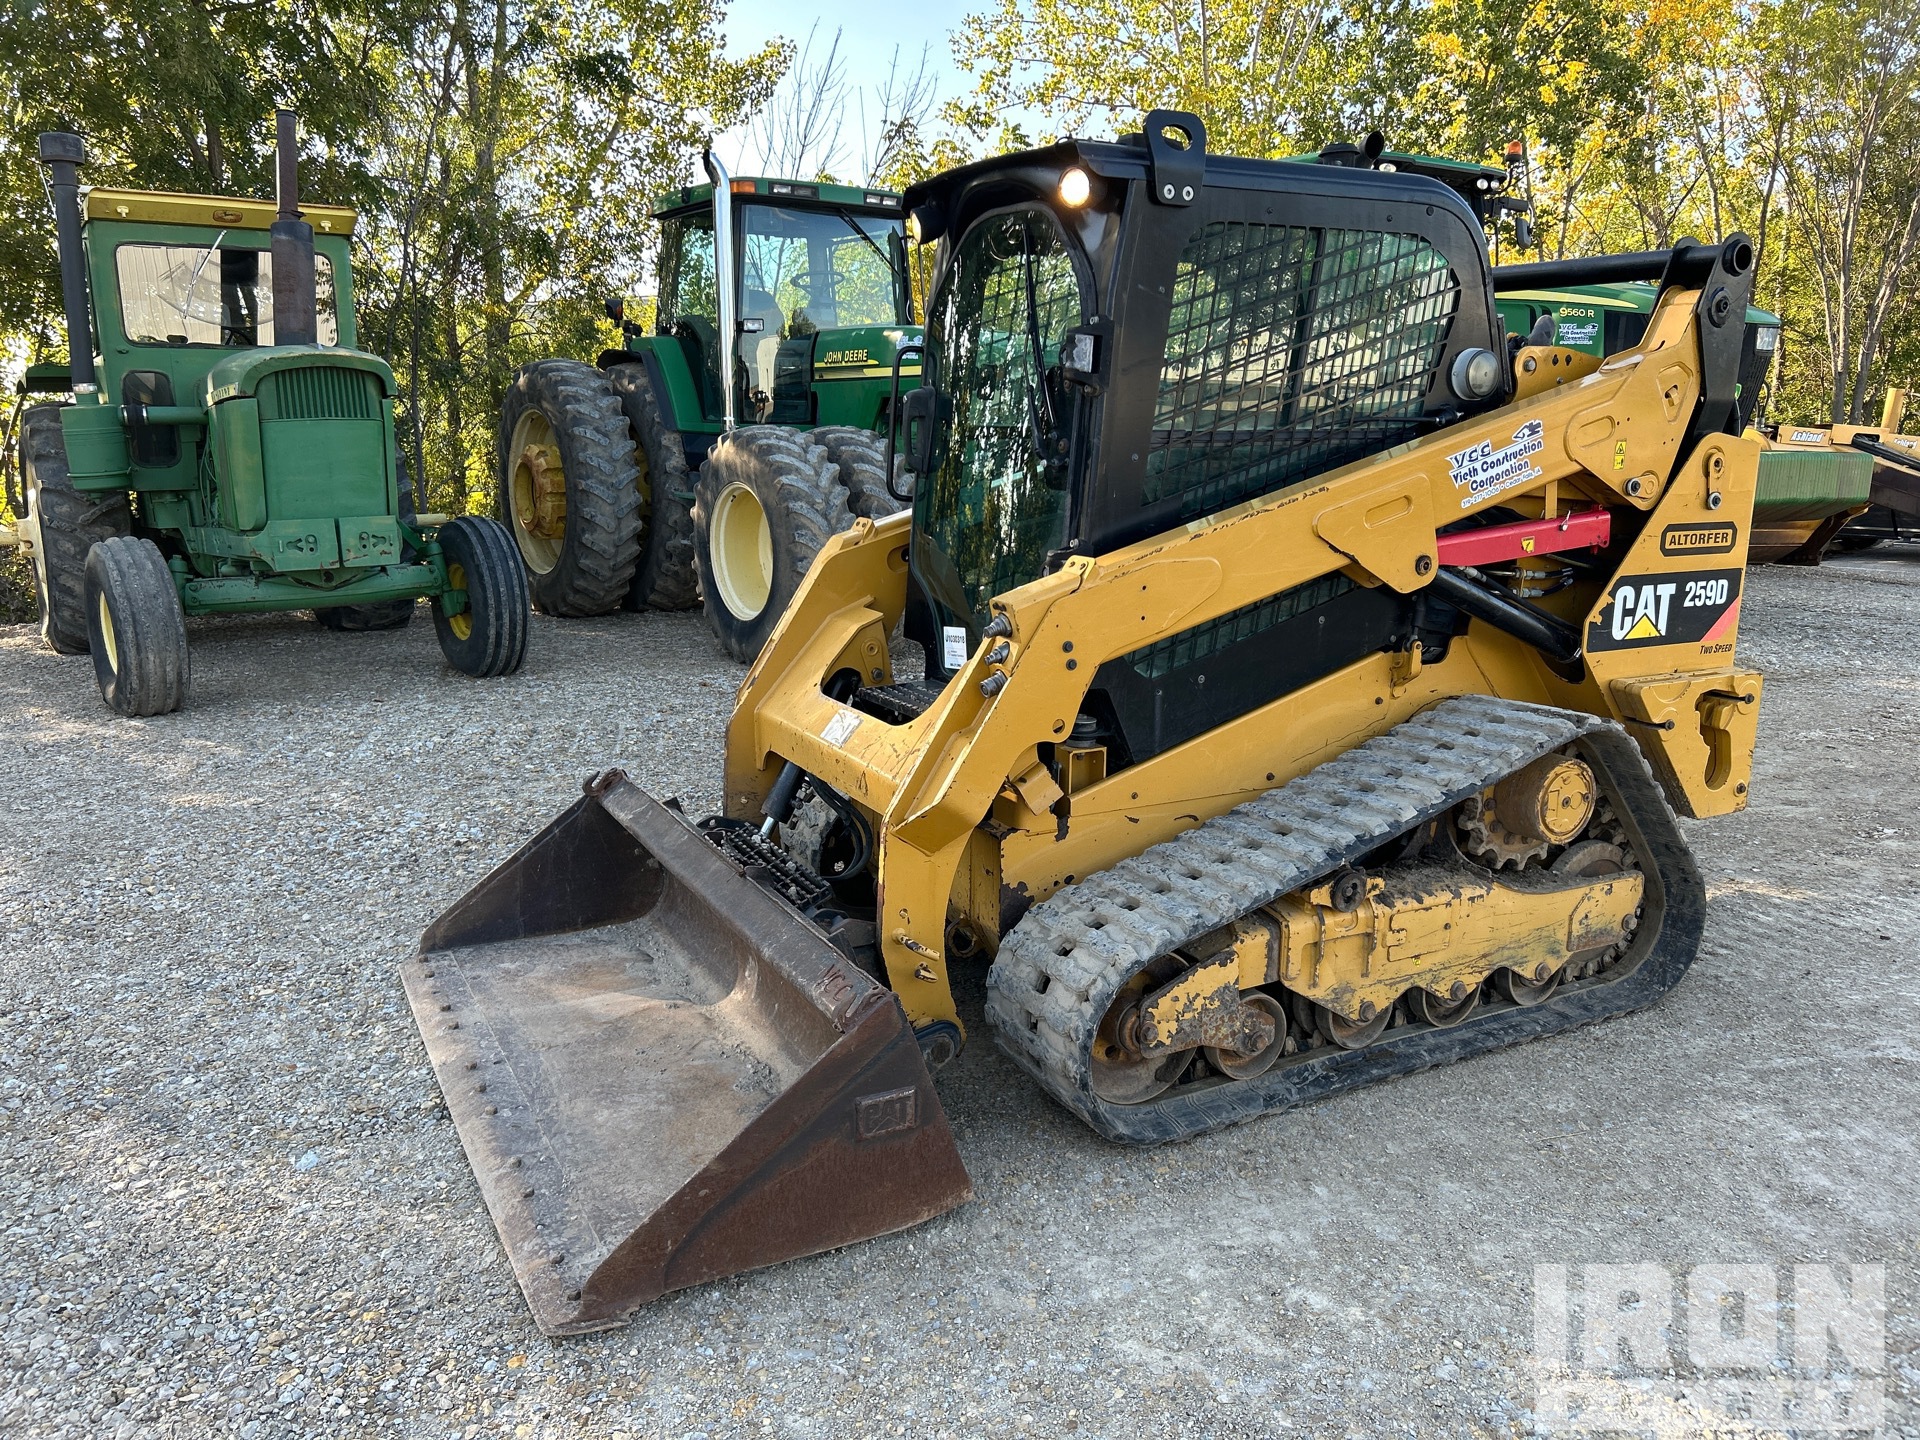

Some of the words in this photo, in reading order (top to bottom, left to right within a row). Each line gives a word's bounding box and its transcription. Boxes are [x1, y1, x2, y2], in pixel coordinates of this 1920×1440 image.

[1560, 307, 1585, 317] 9560
[1588, 309, 1595, 318] R
[824, 351, 842, 362] JOHN
[845, 349, 868, 361] DEERE
[1790, 430, 1823, 443] Ashland
[1450, 441, 1491, 468] VCC
[1452, 464, 1478, 485] Vieth
[1481, 440, 1543, 473] Construction
[1470, 460, 1529, 492] Corporation
[1669, 532, 1729, 546] ALTORFER
[1611, 583, 1676, 640] CAT
[1683, 579, 1728, 607] 259D
[863, 1096, 912, 1132] CAT
